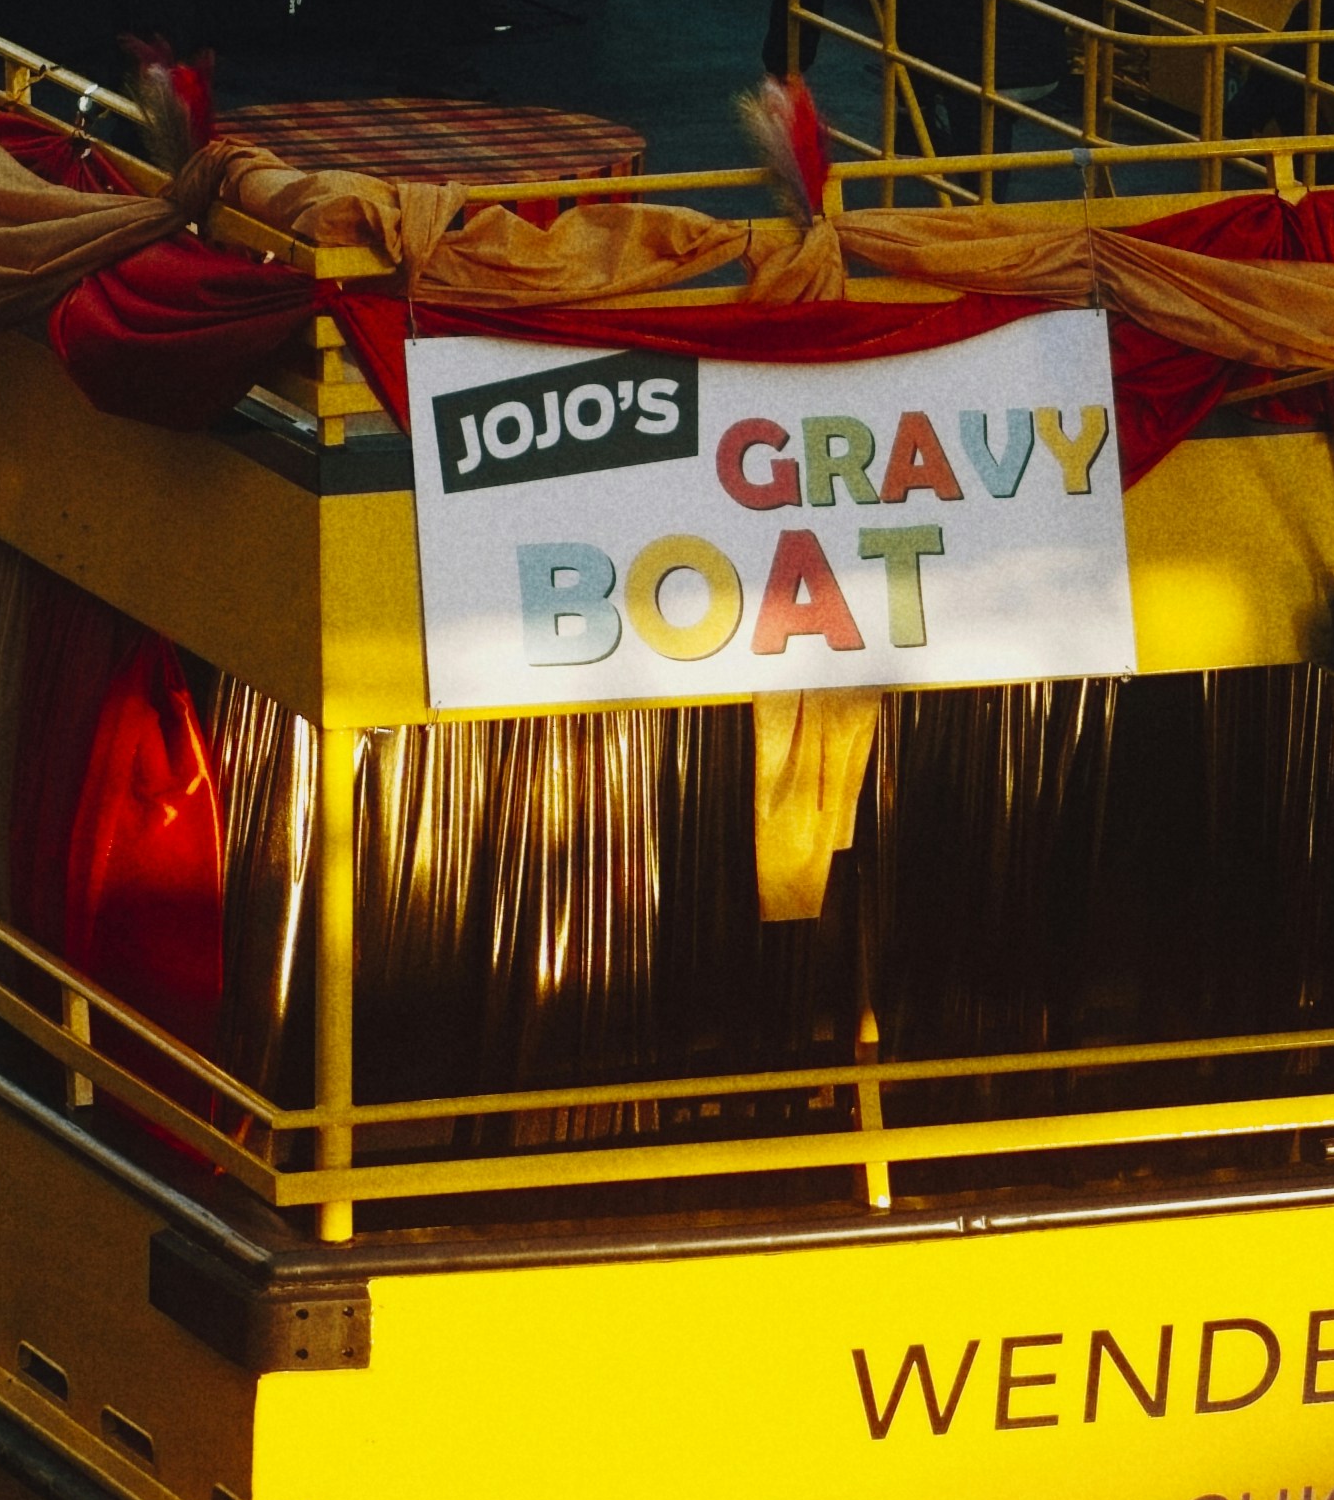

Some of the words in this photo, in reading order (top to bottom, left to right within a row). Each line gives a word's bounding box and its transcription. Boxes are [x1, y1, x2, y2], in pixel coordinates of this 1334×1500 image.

[455, 378, 680, 474] JOJO'S
[715, 405, 1109, 510] GRAVY
[516, 523, 944, 667] BOAT
